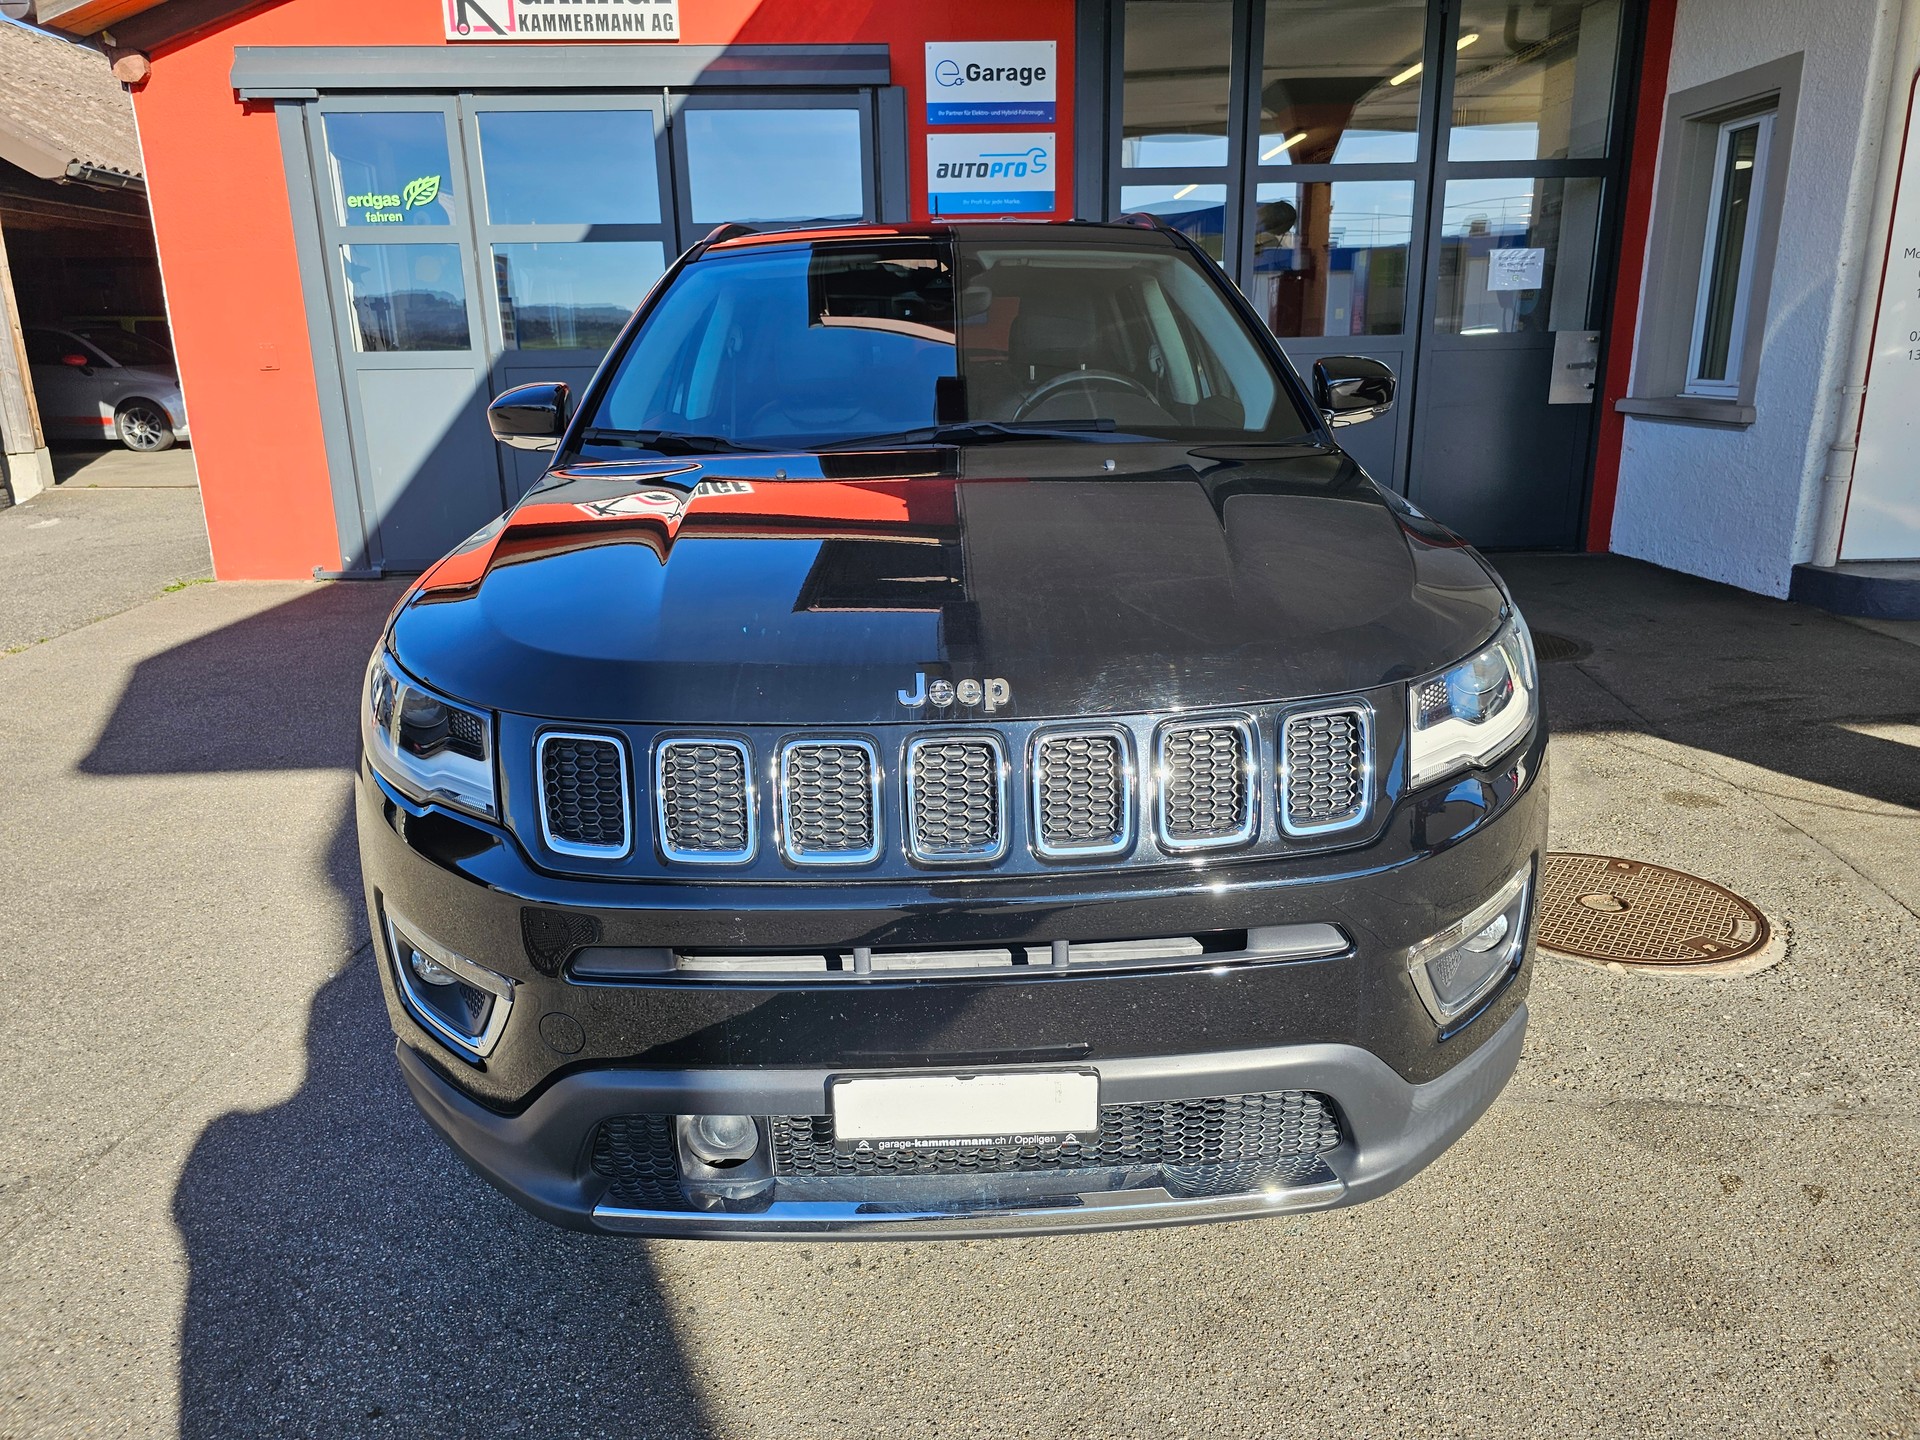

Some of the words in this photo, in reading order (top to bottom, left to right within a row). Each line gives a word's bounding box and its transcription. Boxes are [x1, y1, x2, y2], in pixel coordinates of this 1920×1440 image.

[518, 13, 646, 32] KAMMERMANN
[651, 13, 675, 32] AG
[965, 63, 1047, 86] Garage
[347, 192, 401, 209] erdgas
[365, 212, 403, 223] fahren
[897, 672, 1010, 712] Jeep
[878, 1136, 1006, 1150] garage-kammermann.ch
[1014, 1134, 1057, 1147] Oppligen
